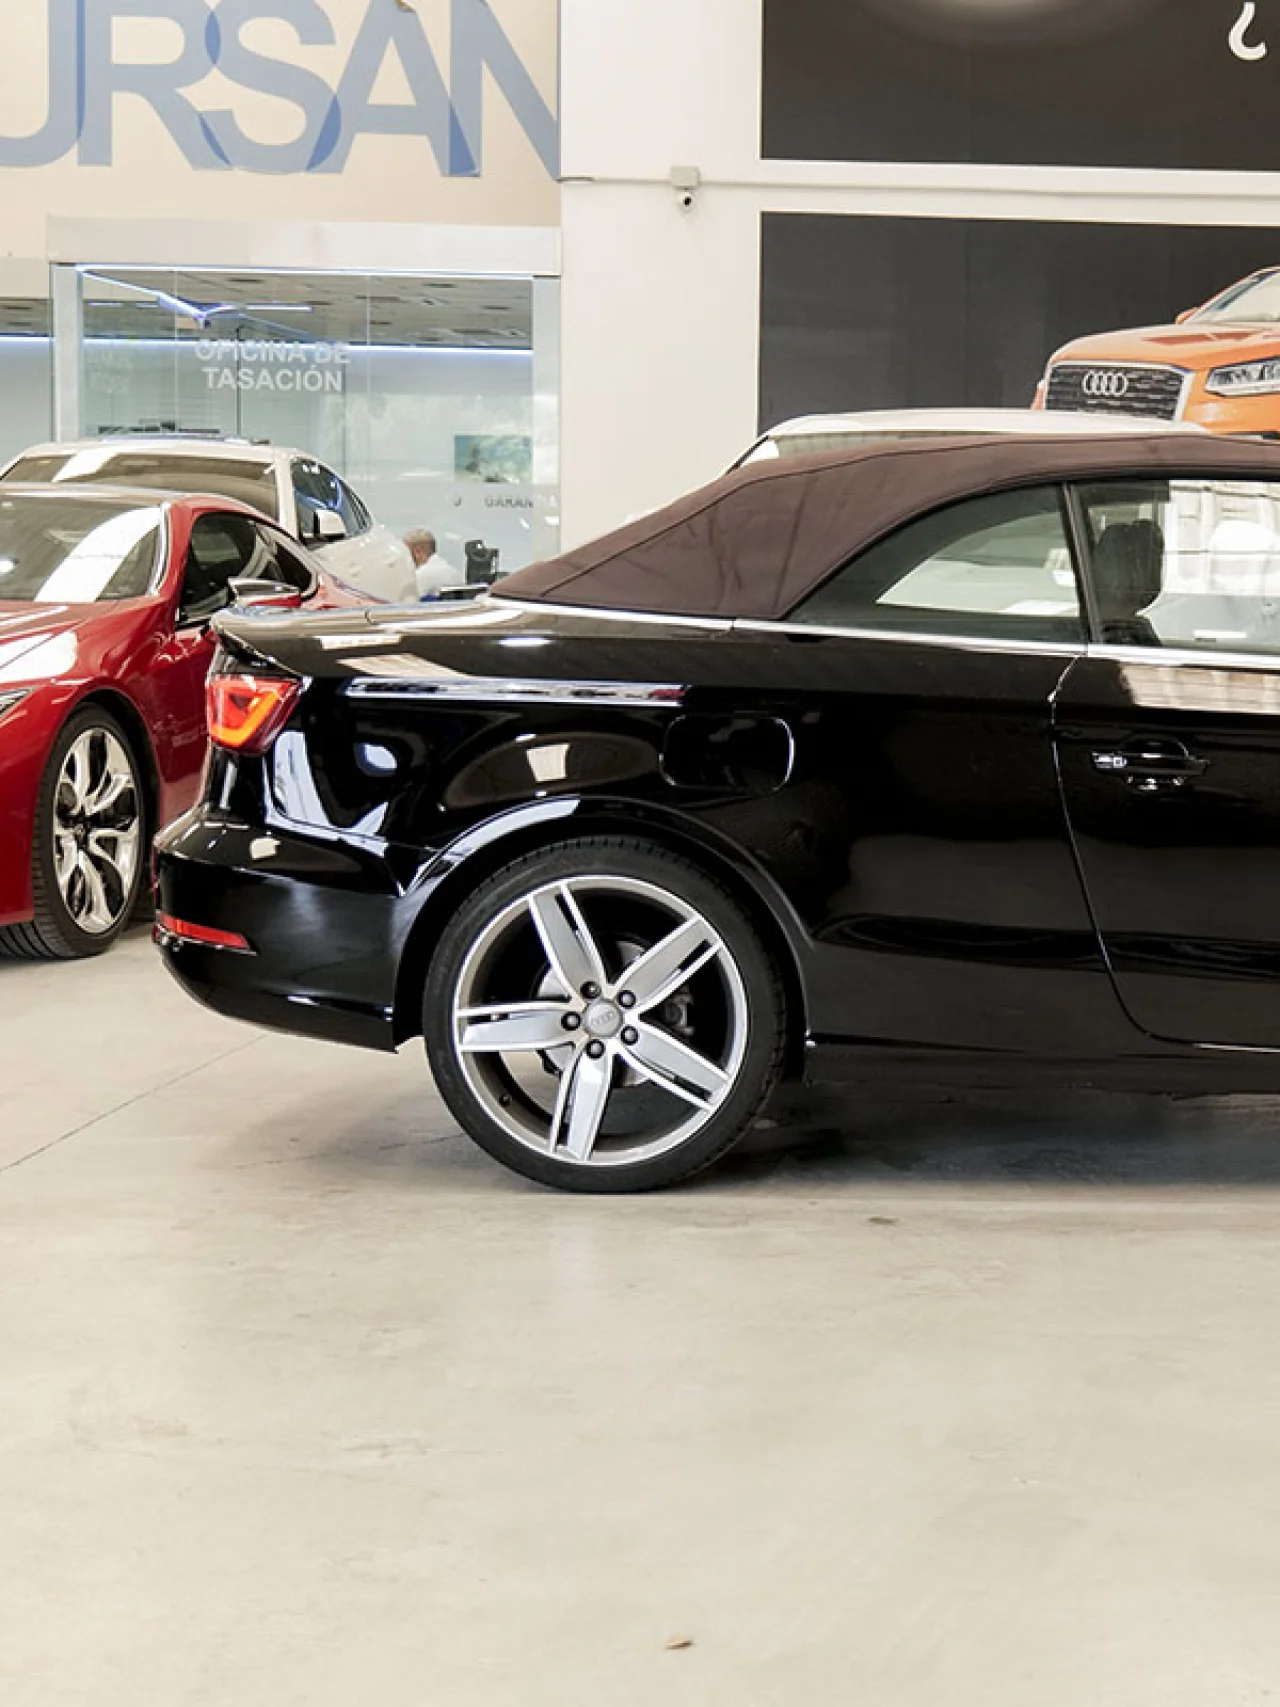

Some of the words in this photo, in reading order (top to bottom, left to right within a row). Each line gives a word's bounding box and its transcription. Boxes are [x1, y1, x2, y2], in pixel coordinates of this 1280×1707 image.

[196, 339, 307, 363] OFICINA
[315, 341, 351, 364] DE
[201, 364, 343, 392] TASACIÓN
